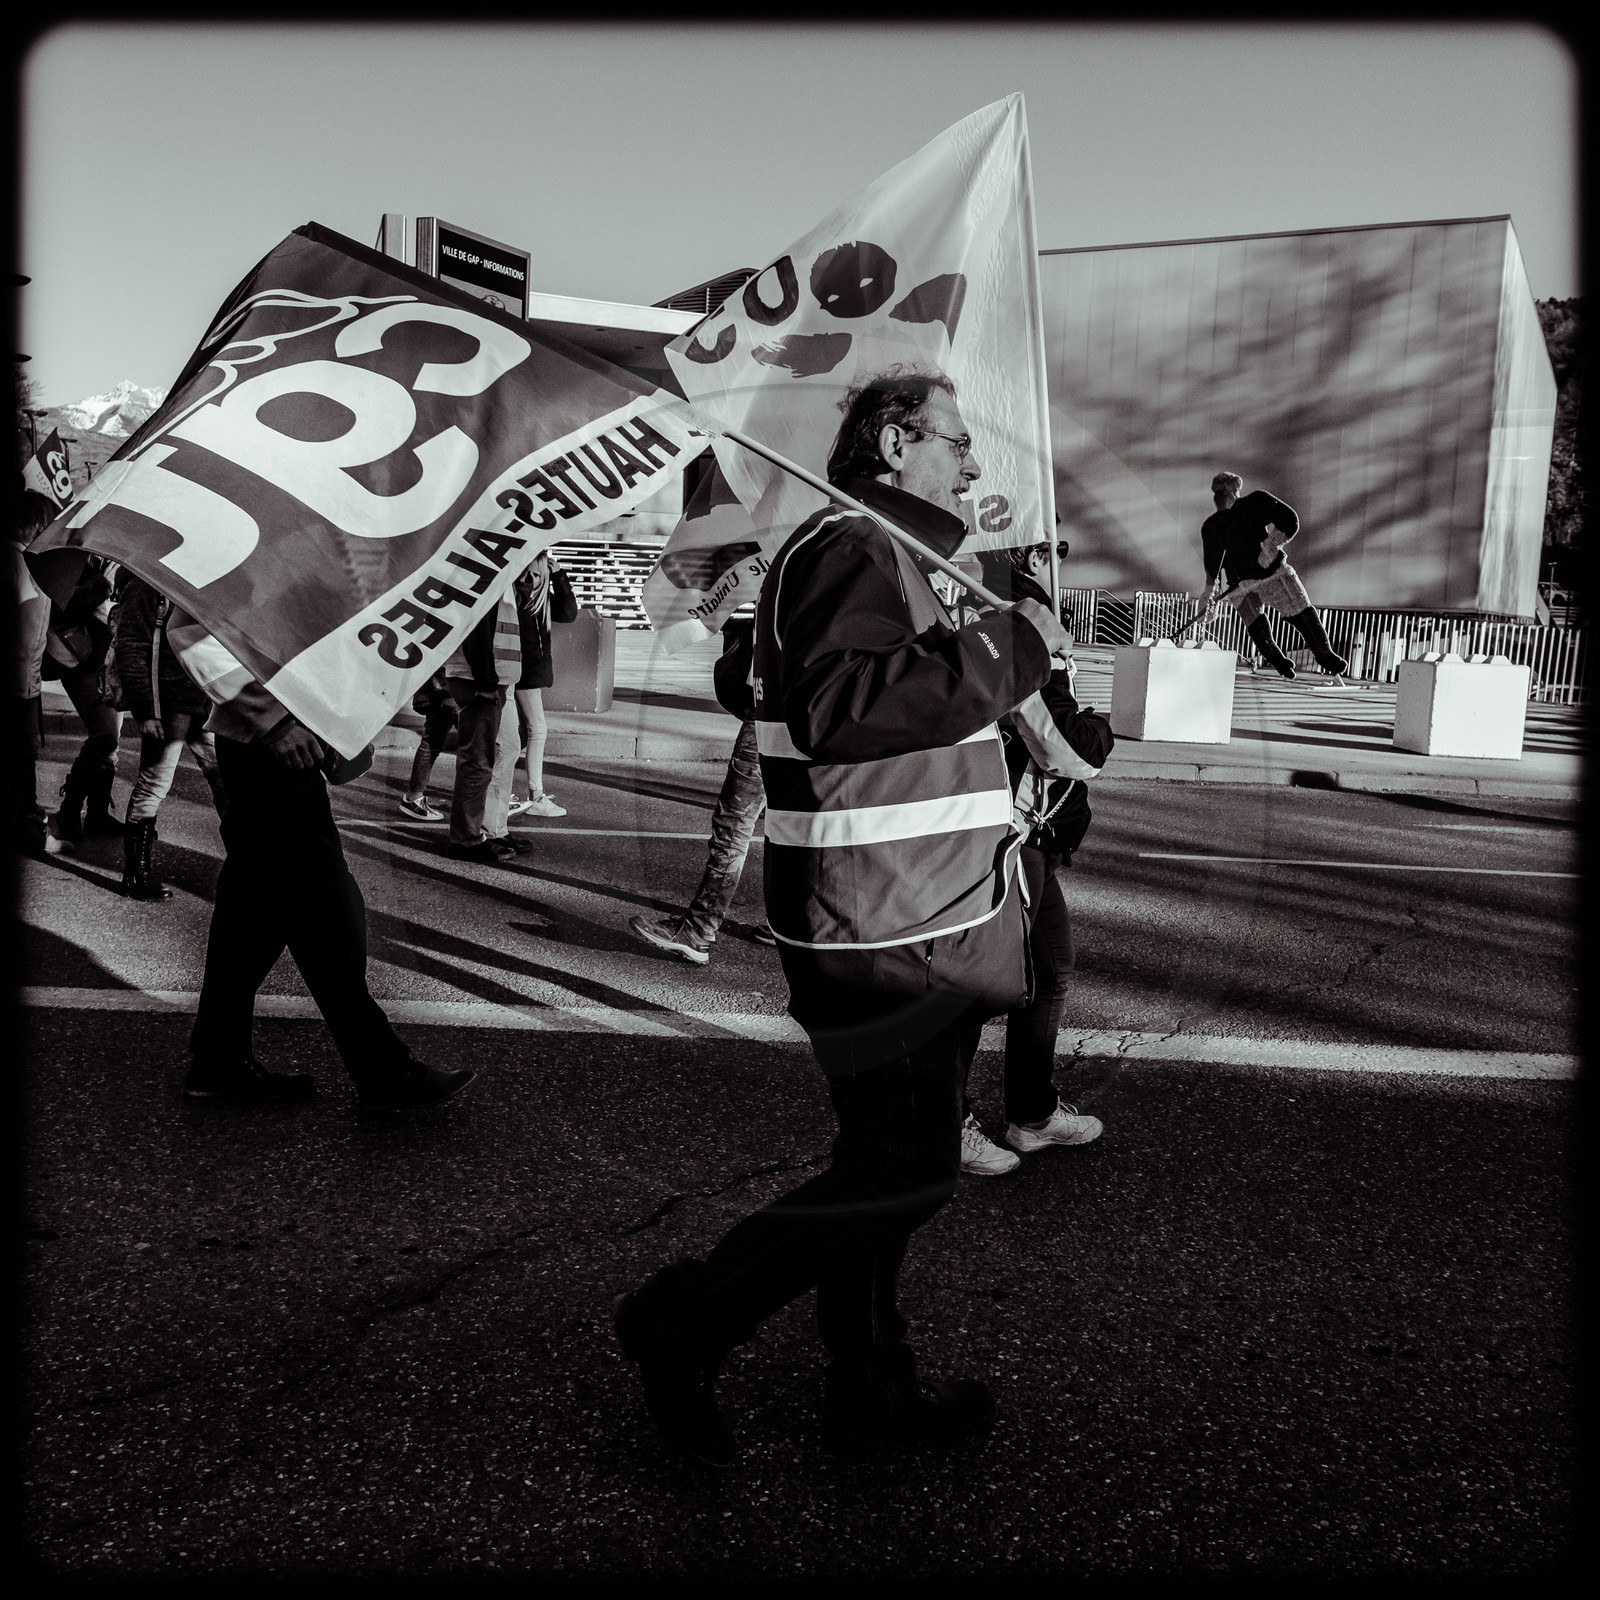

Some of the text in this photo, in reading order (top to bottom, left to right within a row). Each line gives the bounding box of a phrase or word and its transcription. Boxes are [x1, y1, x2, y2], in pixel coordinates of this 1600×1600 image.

[442, 244, 458, 259] VILLE
[458, 250, 467, 261] DE
[467, 253, 480, 265] GAP
[483, 259, 525, 281] INFORMATIONS
